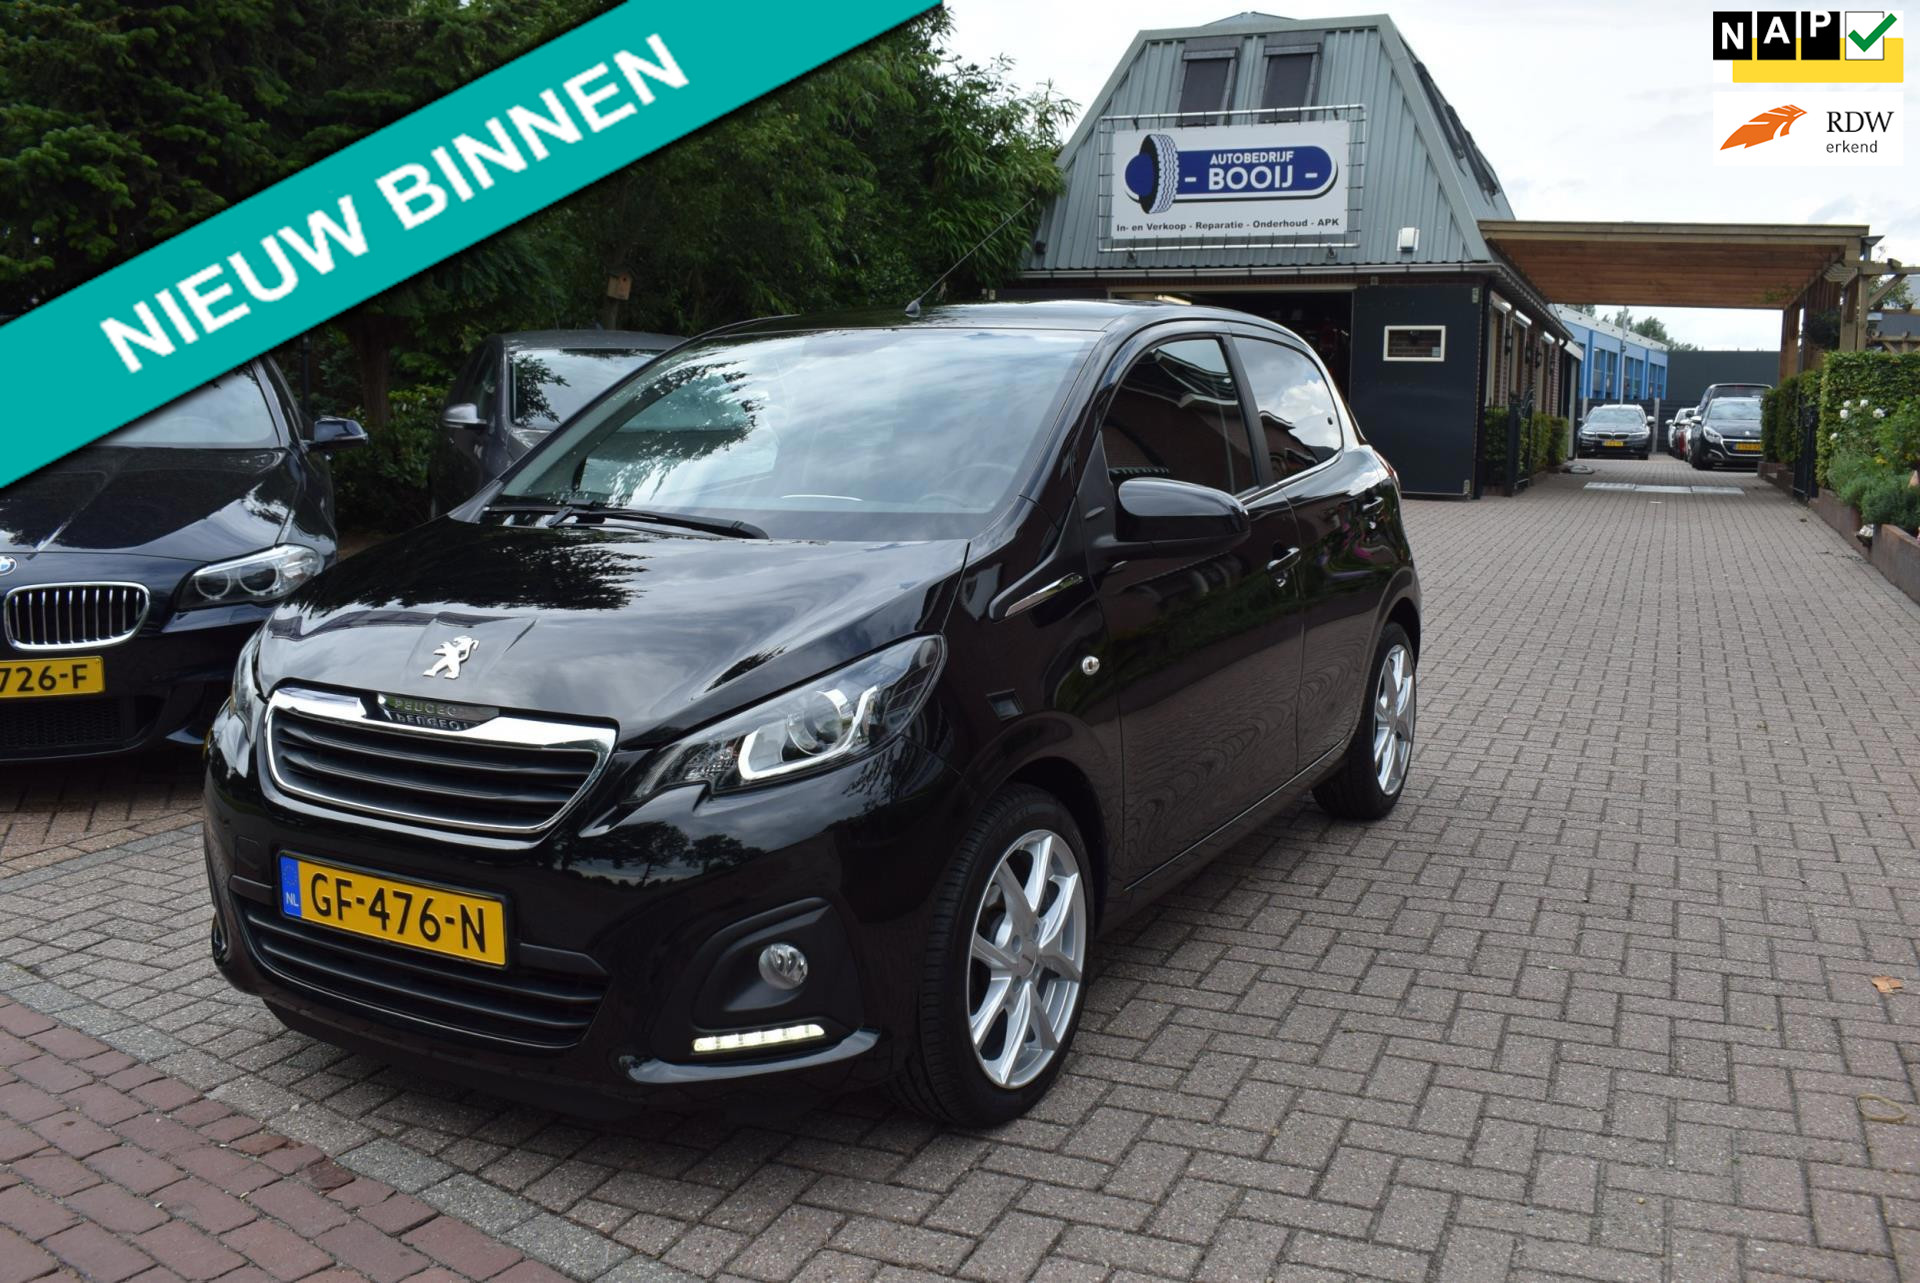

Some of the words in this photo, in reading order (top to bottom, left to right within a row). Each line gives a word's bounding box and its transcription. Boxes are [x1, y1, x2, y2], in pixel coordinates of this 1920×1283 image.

[1210, 151, 1294, 165] AUTOBEDRIJF
[1208, 165, 1293, 191] BOOIJ
[1147, 222, 1187, 231] Verkoop
[1195, 221, 1244, 230] Reparatie
[1252, 219, 1308, 228] Onderhoud
[1317, 218, 1339, 226] APK
[0, 664, 88, 692] 726-F
[285, 892, 299, 907] NL
[310, 872, 487, 953] GF-476-N
